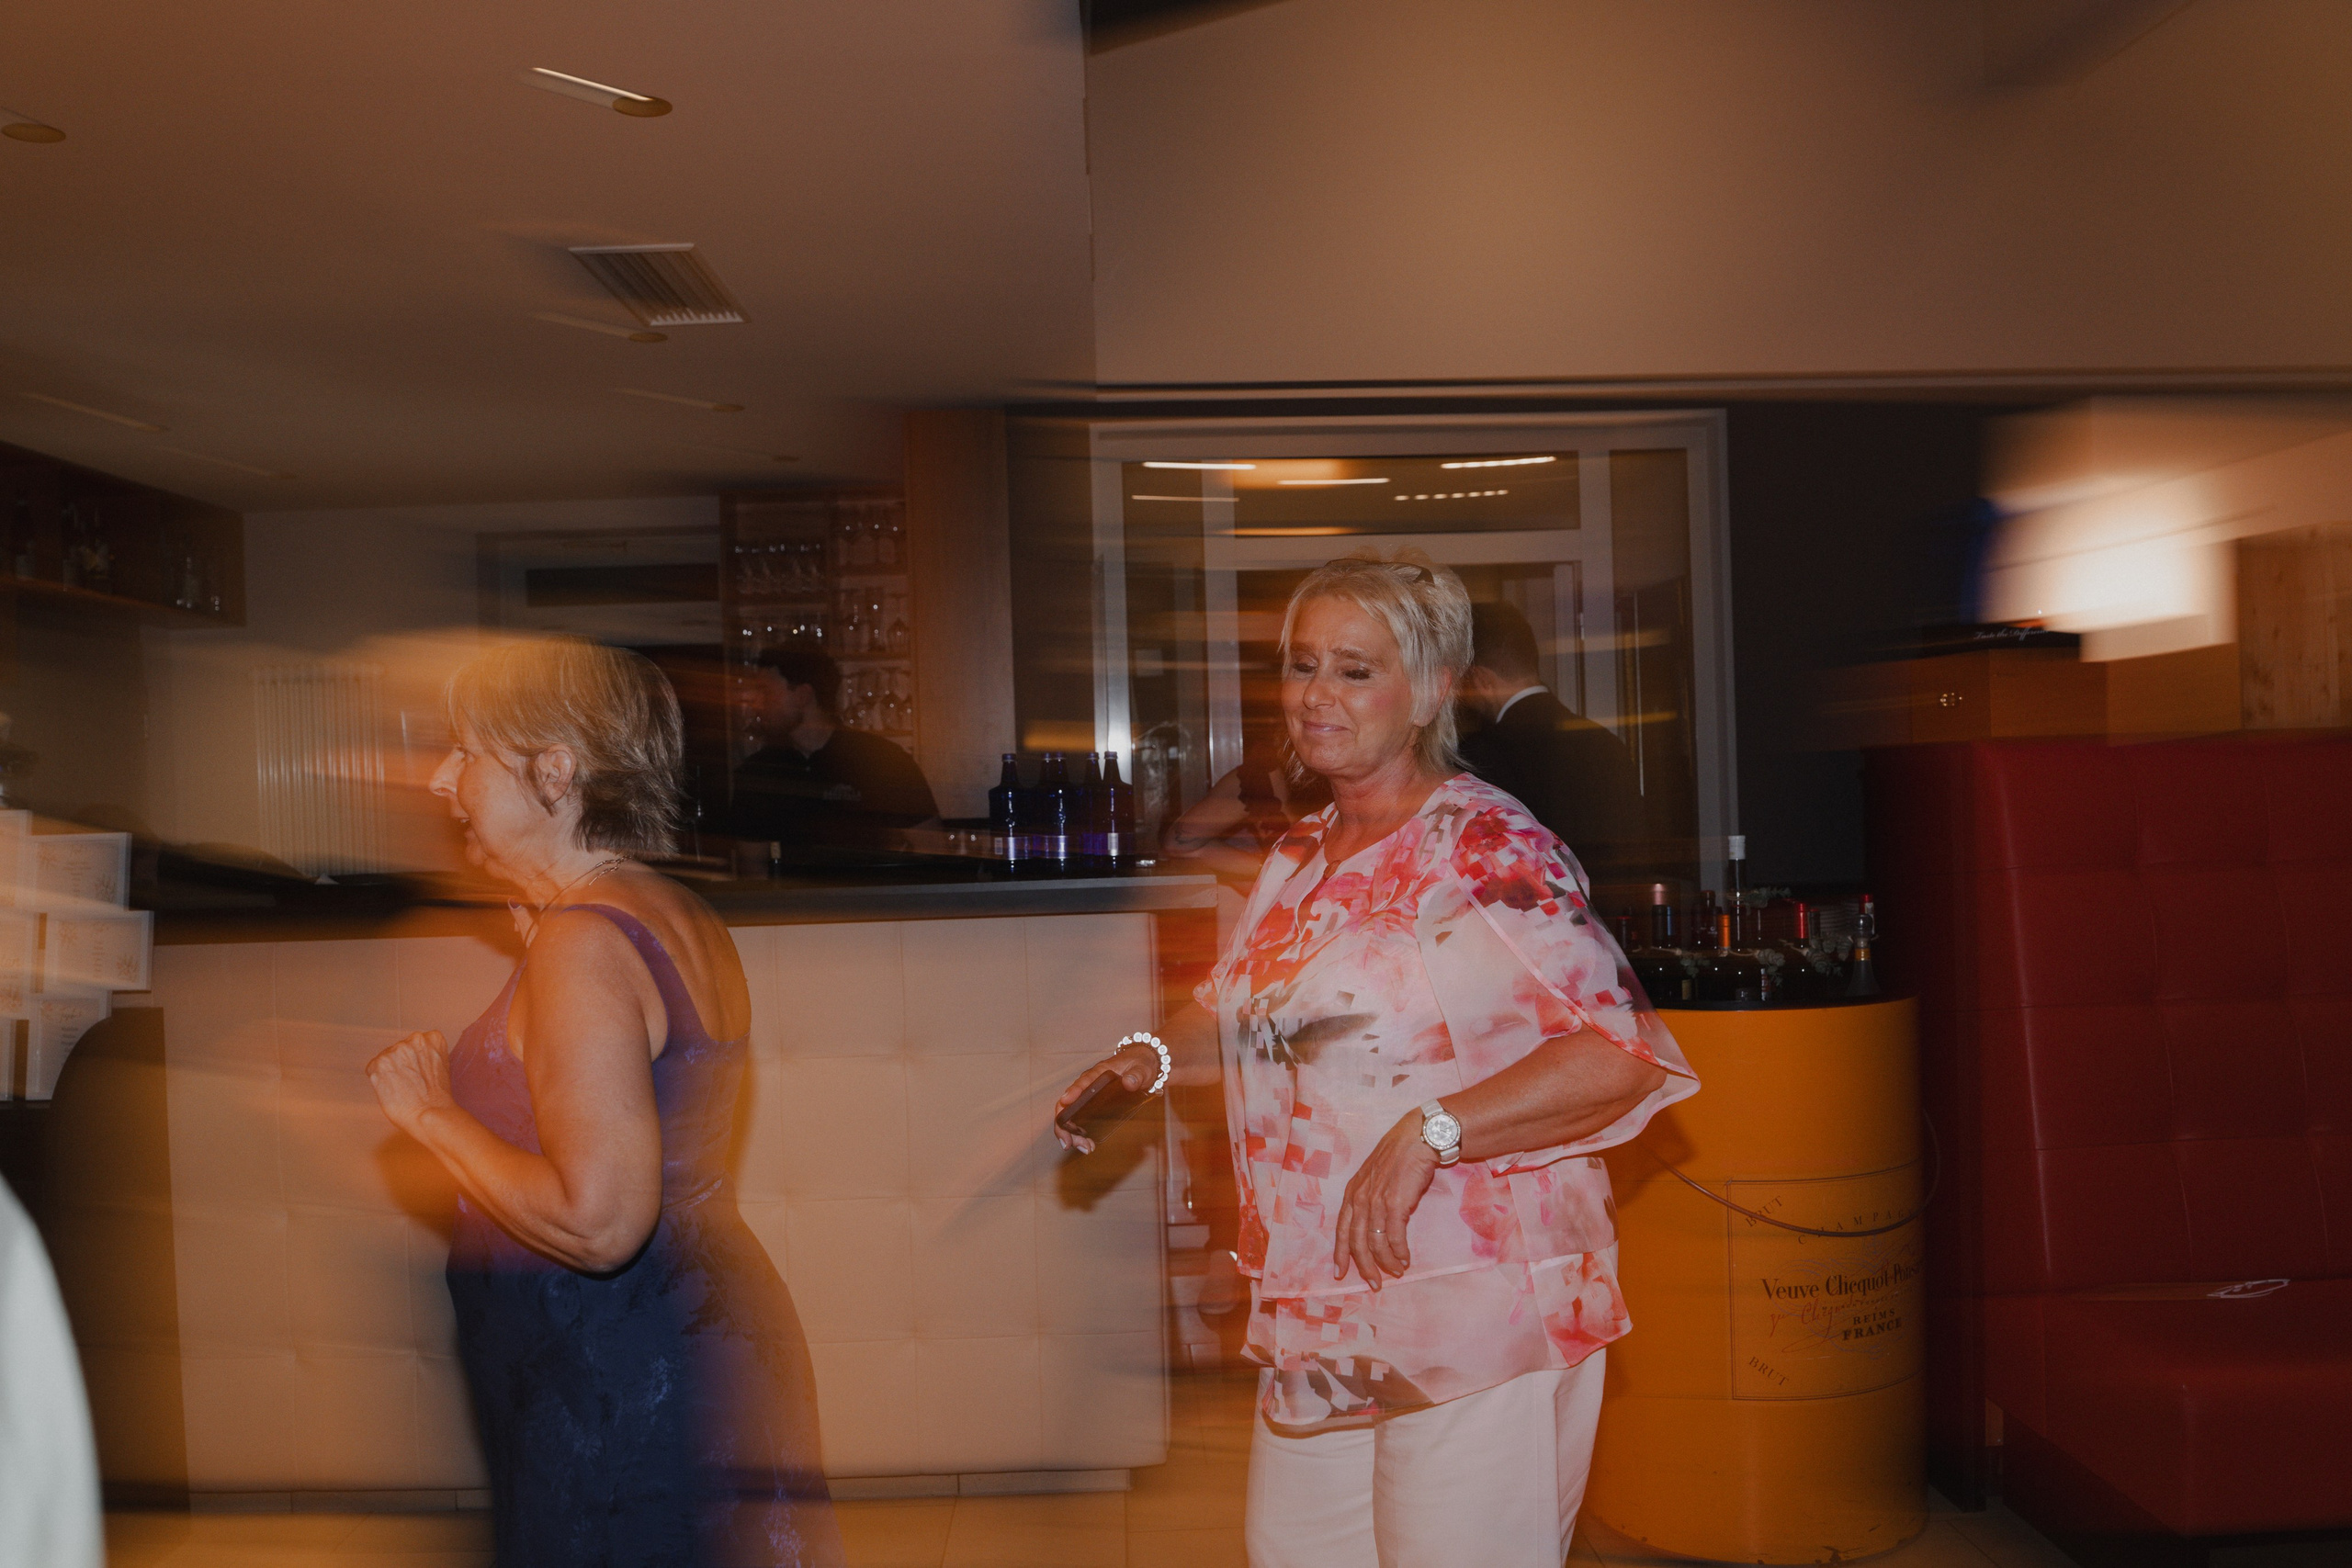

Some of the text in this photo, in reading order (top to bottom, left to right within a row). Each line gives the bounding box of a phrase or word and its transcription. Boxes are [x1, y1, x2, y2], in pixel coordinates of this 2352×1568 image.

[1996, 627, 2008, 638] the
[1746, 1195, 1783, 1227] BRUT
[1761, 1278, 1820, 1300] Veuve
[1826, 1269, 1890, 1296] Clicquot
[1843, 1317, 1902, 1341] FRANCE
[1853, 1308, 1895, 1325] REIMS
[1748, 1356, 1790, 1386] BRUT
